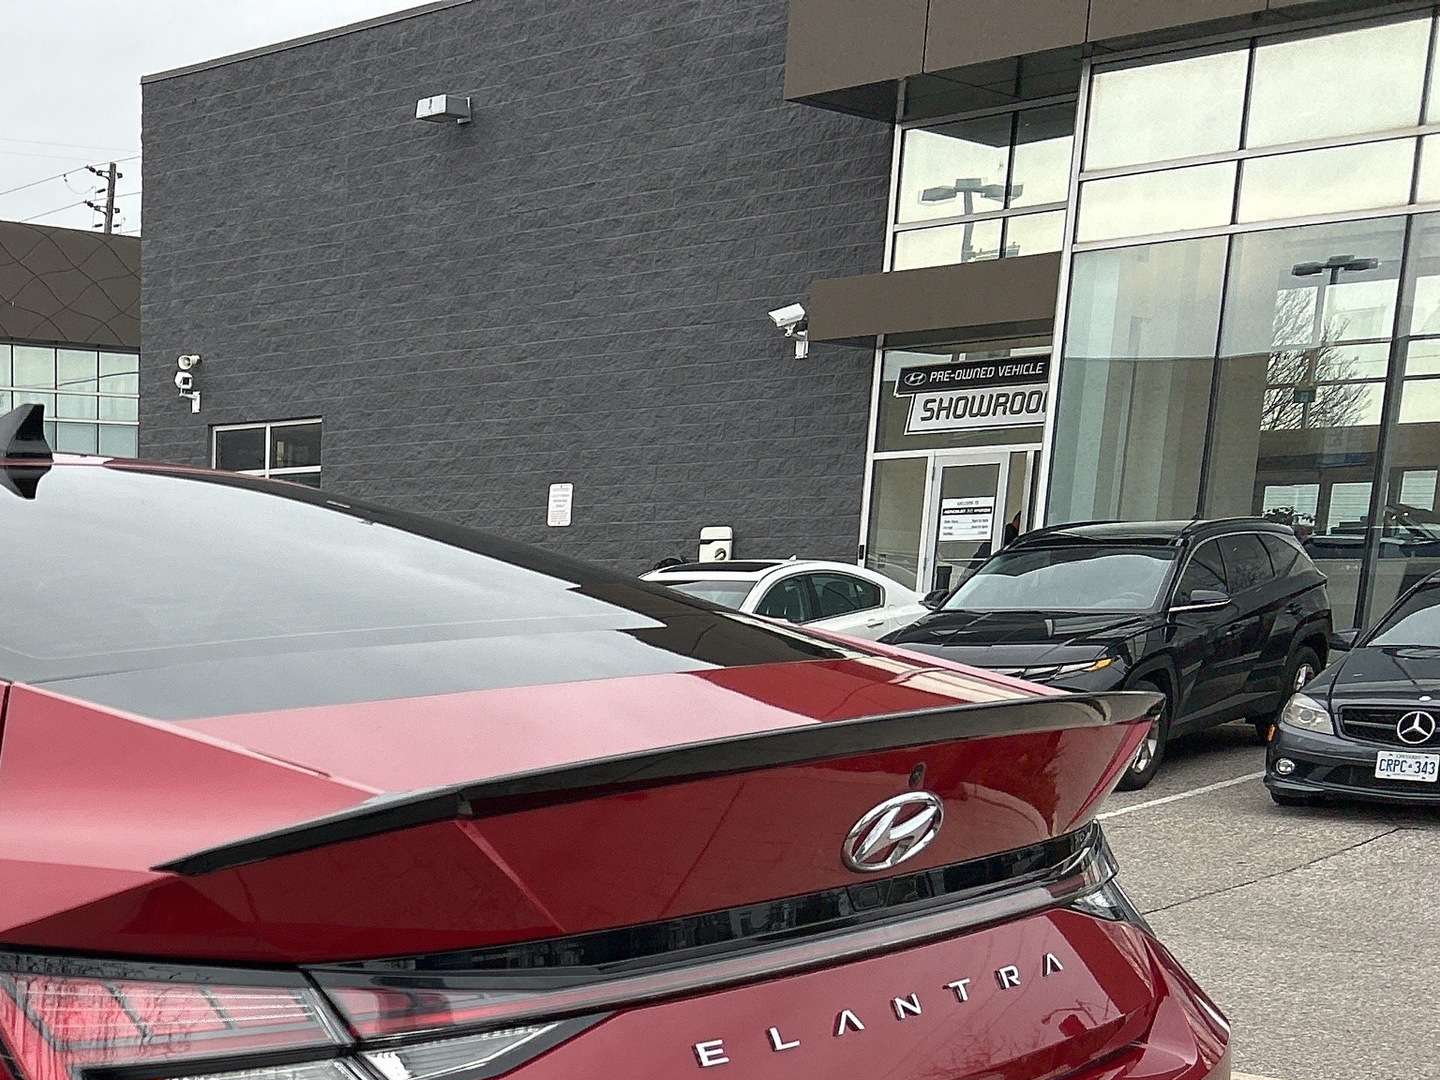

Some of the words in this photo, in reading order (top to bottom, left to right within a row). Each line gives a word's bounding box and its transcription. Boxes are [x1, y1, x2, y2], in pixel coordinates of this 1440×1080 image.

[930, 367, 995, 382] PRE-OWNED
[998, 363, 1045, 376] VEHICLE
[921, 390, 1047, 421] SHOWROO
[1379, 758, 1407, 773] CRPC
[1414, 760, 1436, 775] 343
[694, 952, 1065, 1068] ELANTRA
